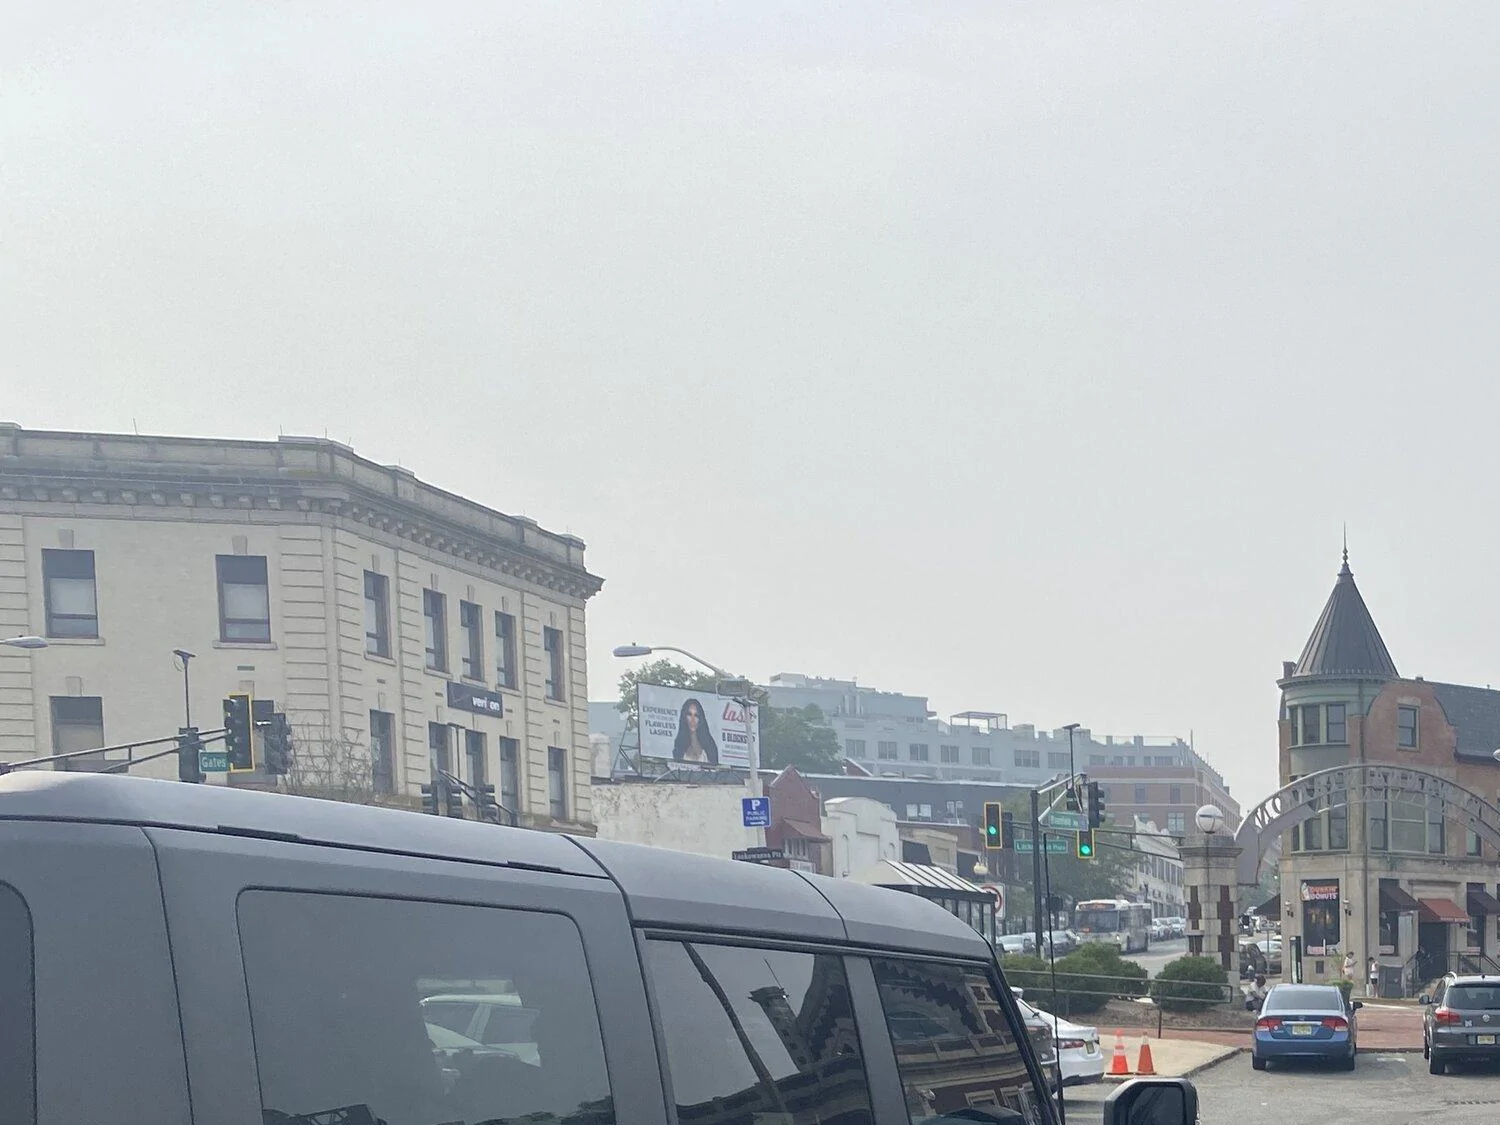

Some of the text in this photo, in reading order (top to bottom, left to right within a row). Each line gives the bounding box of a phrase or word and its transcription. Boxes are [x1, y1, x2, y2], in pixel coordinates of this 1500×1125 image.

[642, 704, 678, 716] EXPERIENCE
[645, 720, 676, 730] FLAWLESS
[649, 728, 673, 737] LASHES
[201, 756, 227, 768] Gates
[751, 799, 761, 811] P
[1310, 892, 1338, 900] DONUTS
